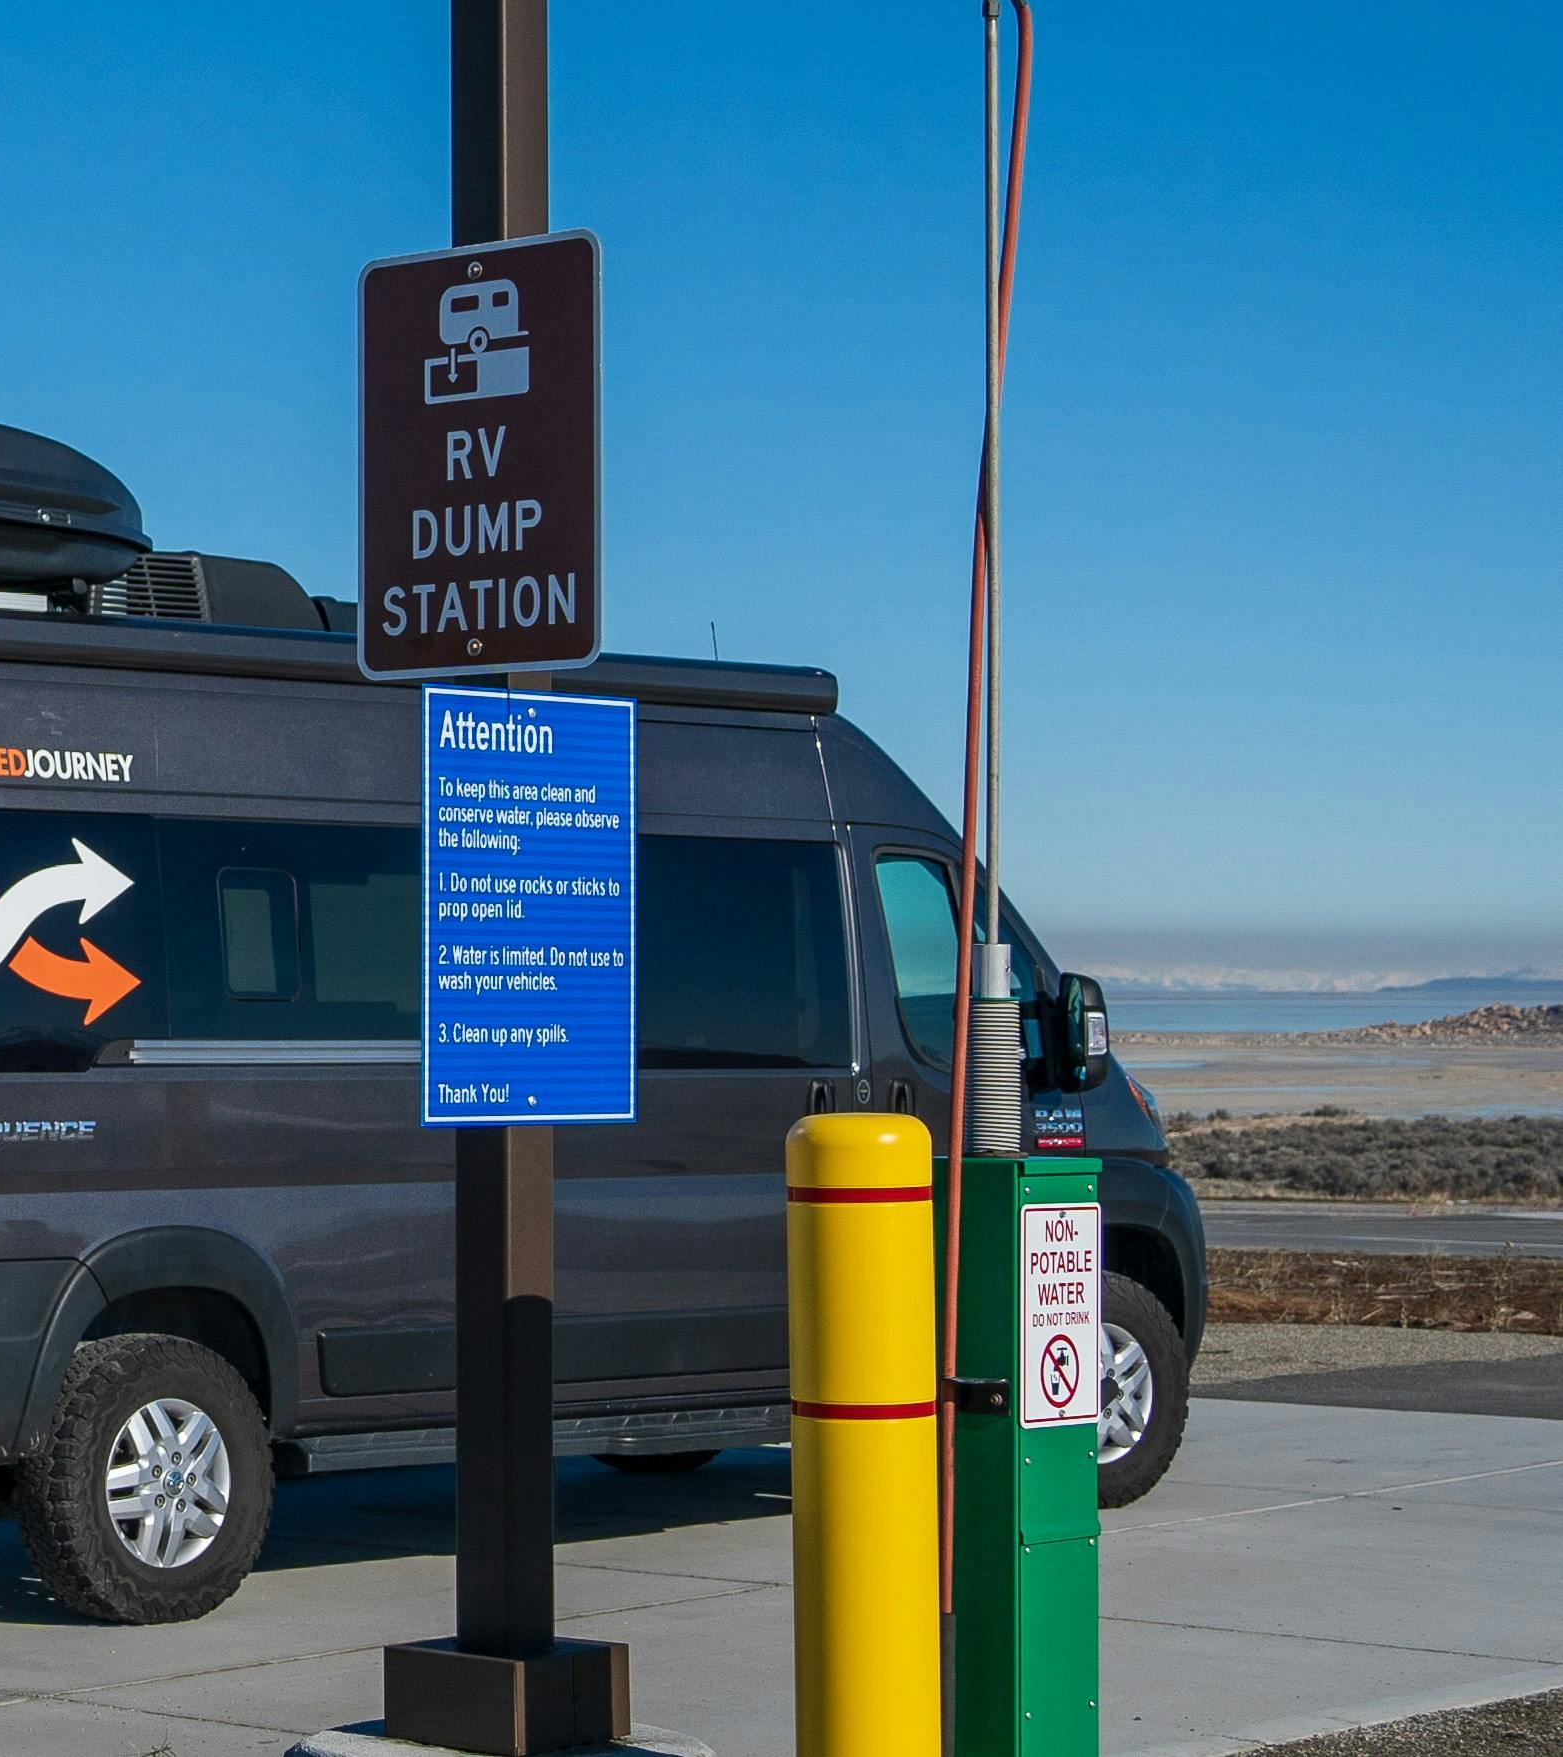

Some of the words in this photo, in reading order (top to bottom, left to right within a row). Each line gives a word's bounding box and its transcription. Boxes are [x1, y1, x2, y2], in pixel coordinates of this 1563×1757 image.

[446, 425, 506, 481] RV
[412, 499, 542, 560] DUMP
[382, 572, 576, 637] STATION
[439, 710, 554, 754] Attention
[439, 777, 454, 797] To
[456, 778, 486, 802] keep
[489, 780, 511, 800] this
[513, 785, 538, 801] area
[541, 783, 572, 802] clean
[574, 785, 596, 804] and
[439, 807, 494, 823] conserve
[536, 808, 573, 829] please
[575, 809, 620, 829] observe
[439, 828, 458, 848] the
[462, 829, 521, 856] following:
[439, 872, 447, 892] 1.
[451, 873, 467, 893] Do
[471, 874, 492, 893] not
[495, 878, 516, 894] use
[520, 876, 553, 895] rocks
[556, 880, 569, 895] or
[572, 877, 606, 897] sticks
[609, 878, 620, 897] to
[438, 902, 468, 922] prop
[472, 902, 503, 922] open
[506, 900, 526, 919] lid.
[438, 945, 450, 965] 2.
[452, 945, 487, 966] Water
[490, 946, 500, 966] is
[503, 946, 547, 966] limited.
[550, 947, 566, 967] Do
[568, 948, 588, 967] not
[591, 952, 610, 967] use
[613, 949, 624, 967] to
[438, 971, 472, 990] wash
[474, 974, 503, 995] your
[506, 971, 558, 991] vehicles.
[438, 1023, 450, 1043] 3.
[453, 1023, 488, 1043] Clean
[491, 1028, 508, 1047] up
[510, 1028, 534, 1047] any
[536, 1024, 570, 1047] spills.
[438, 1083, 478, 1104] Thank
[481, 1083, 510, 1103] You!
[1044, 1219, 1079, 1243] NON-
[1030, 1249, 1093, 1275] POTABLE
[1037, 1281, 1085, 1306] WATER
[1032, 1313, 1045, 1328] DO
[1046, 1312, 1064, 1327] NOT
[1065, 1310, 1091, 1326] DRINK
